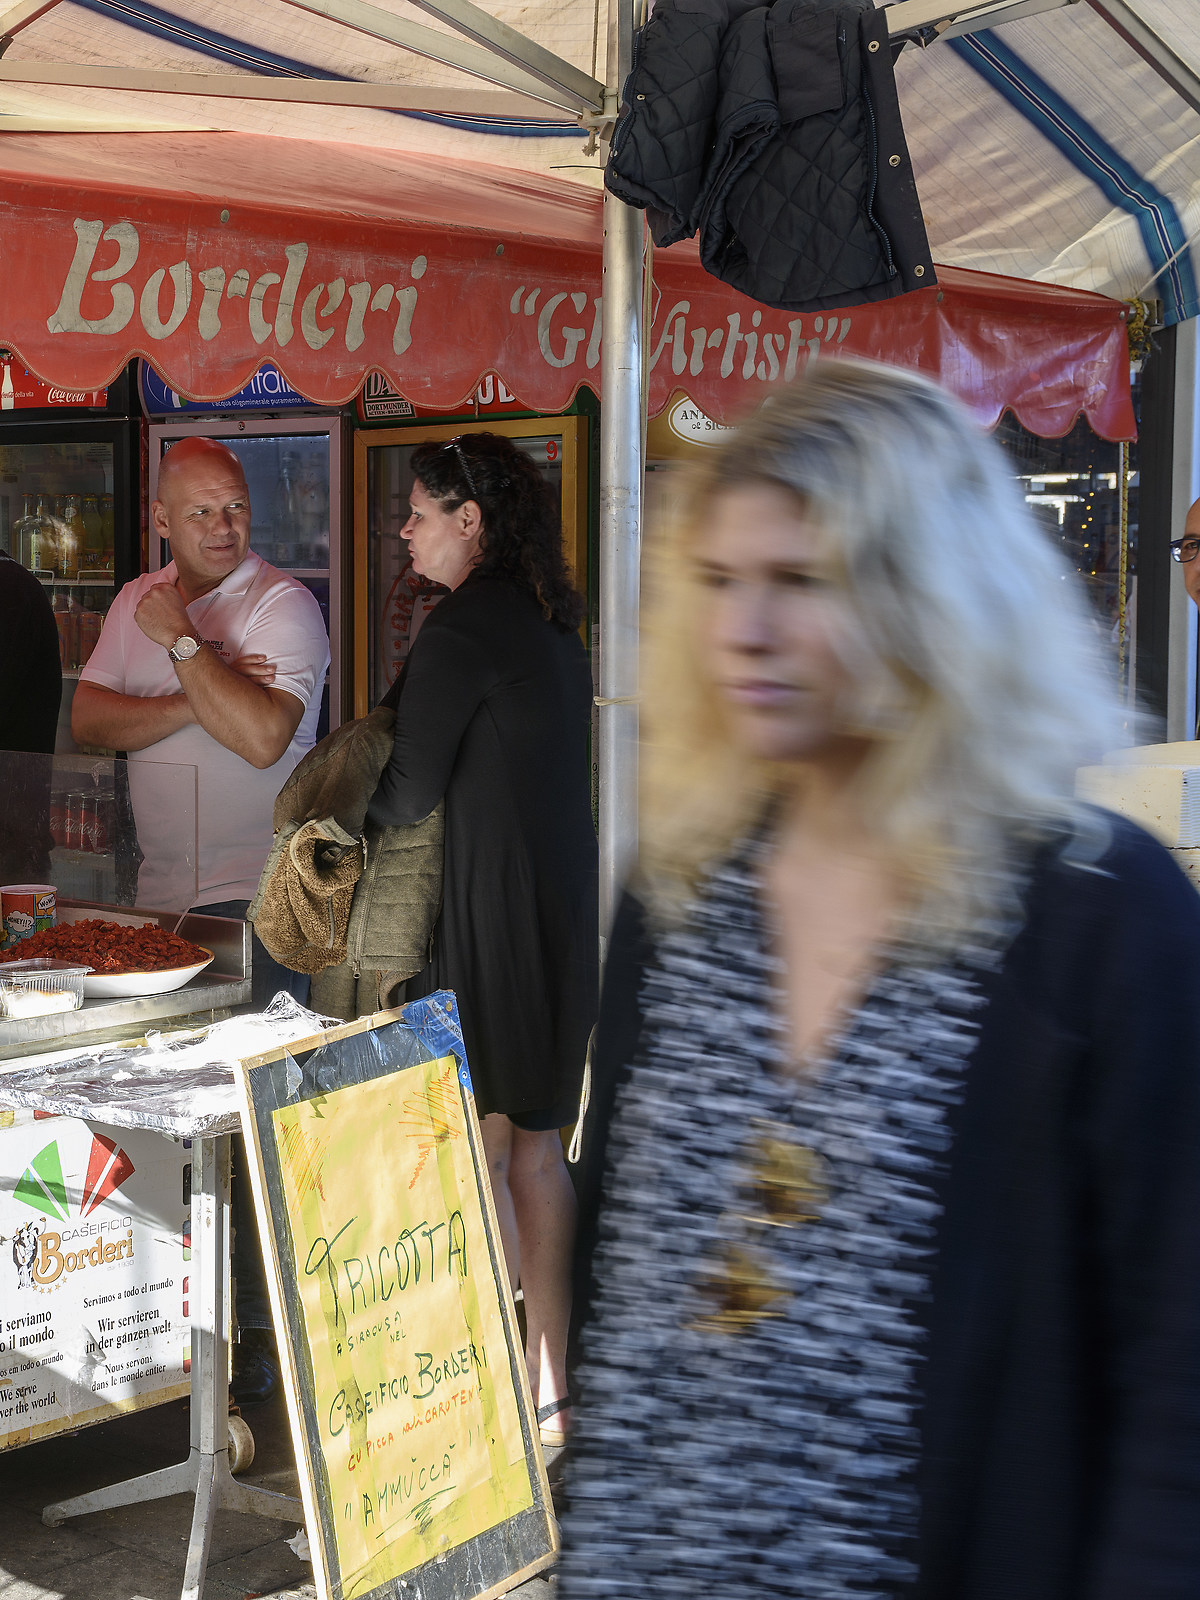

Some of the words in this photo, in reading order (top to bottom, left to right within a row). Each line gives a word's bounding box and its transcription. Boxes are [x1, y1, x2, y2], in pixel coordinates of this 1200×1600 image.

[47, 217, 427, 355] Borderi
[369, 372, 394, 396] DA
[368, 401, 409, 412] DORTMUNDER
[546, 440, 558, 461] 9
[61, 1216, 132, 1242] CASEIFICIO
[32, 1229, 135, 1285] Borderi
[83, 1295, 116, 1308] Servimos
[117, 1292, 122, 1300] a
[124, 1286, 140, 1298] todo
[141, 1283, 148, 1294] el
[149, 1278, 174, 1292] mundo
[6, 1310, 52, 1332] serviamo
[97, 1317, 115, 1333] Wir
[117, 1308, 160, 1328] servieren
[9, 1334, 16, 1350] il
[19, 1326, 55, 1348] mondo
[86, 1341, 95, 1354] in
[98, 1336, 114, 1351] der
[116, 1327, 150, 1349] ganzen
[390, 1329, 407, 1343] NEL
[9, 1366, 19, 1375] em
[20, 1361, 35, 1372] todo
[35, 1359, 41, 1367] o
[41, 1352, 64, 1366] mundo
[105, 1361, 124, 1376] Nous
[126, 1355, 153, 1370] servons
[91, 1380, 109, 1392] dans
[111, 1376, 118, 1387] le
[119, 1369, 144, 1385] monde
[145, 1364, 167, 1377] entier
[0, 1389, 13, 1403] We
[15, 1384, 38, 1399] serve
[15, 1401, 29, 1415] the
[31, 1391, 56, 1410] world
[329, 1374, 409, 1438] CASEIFICIO
[366, 1432, 394, 1458] PICCA
